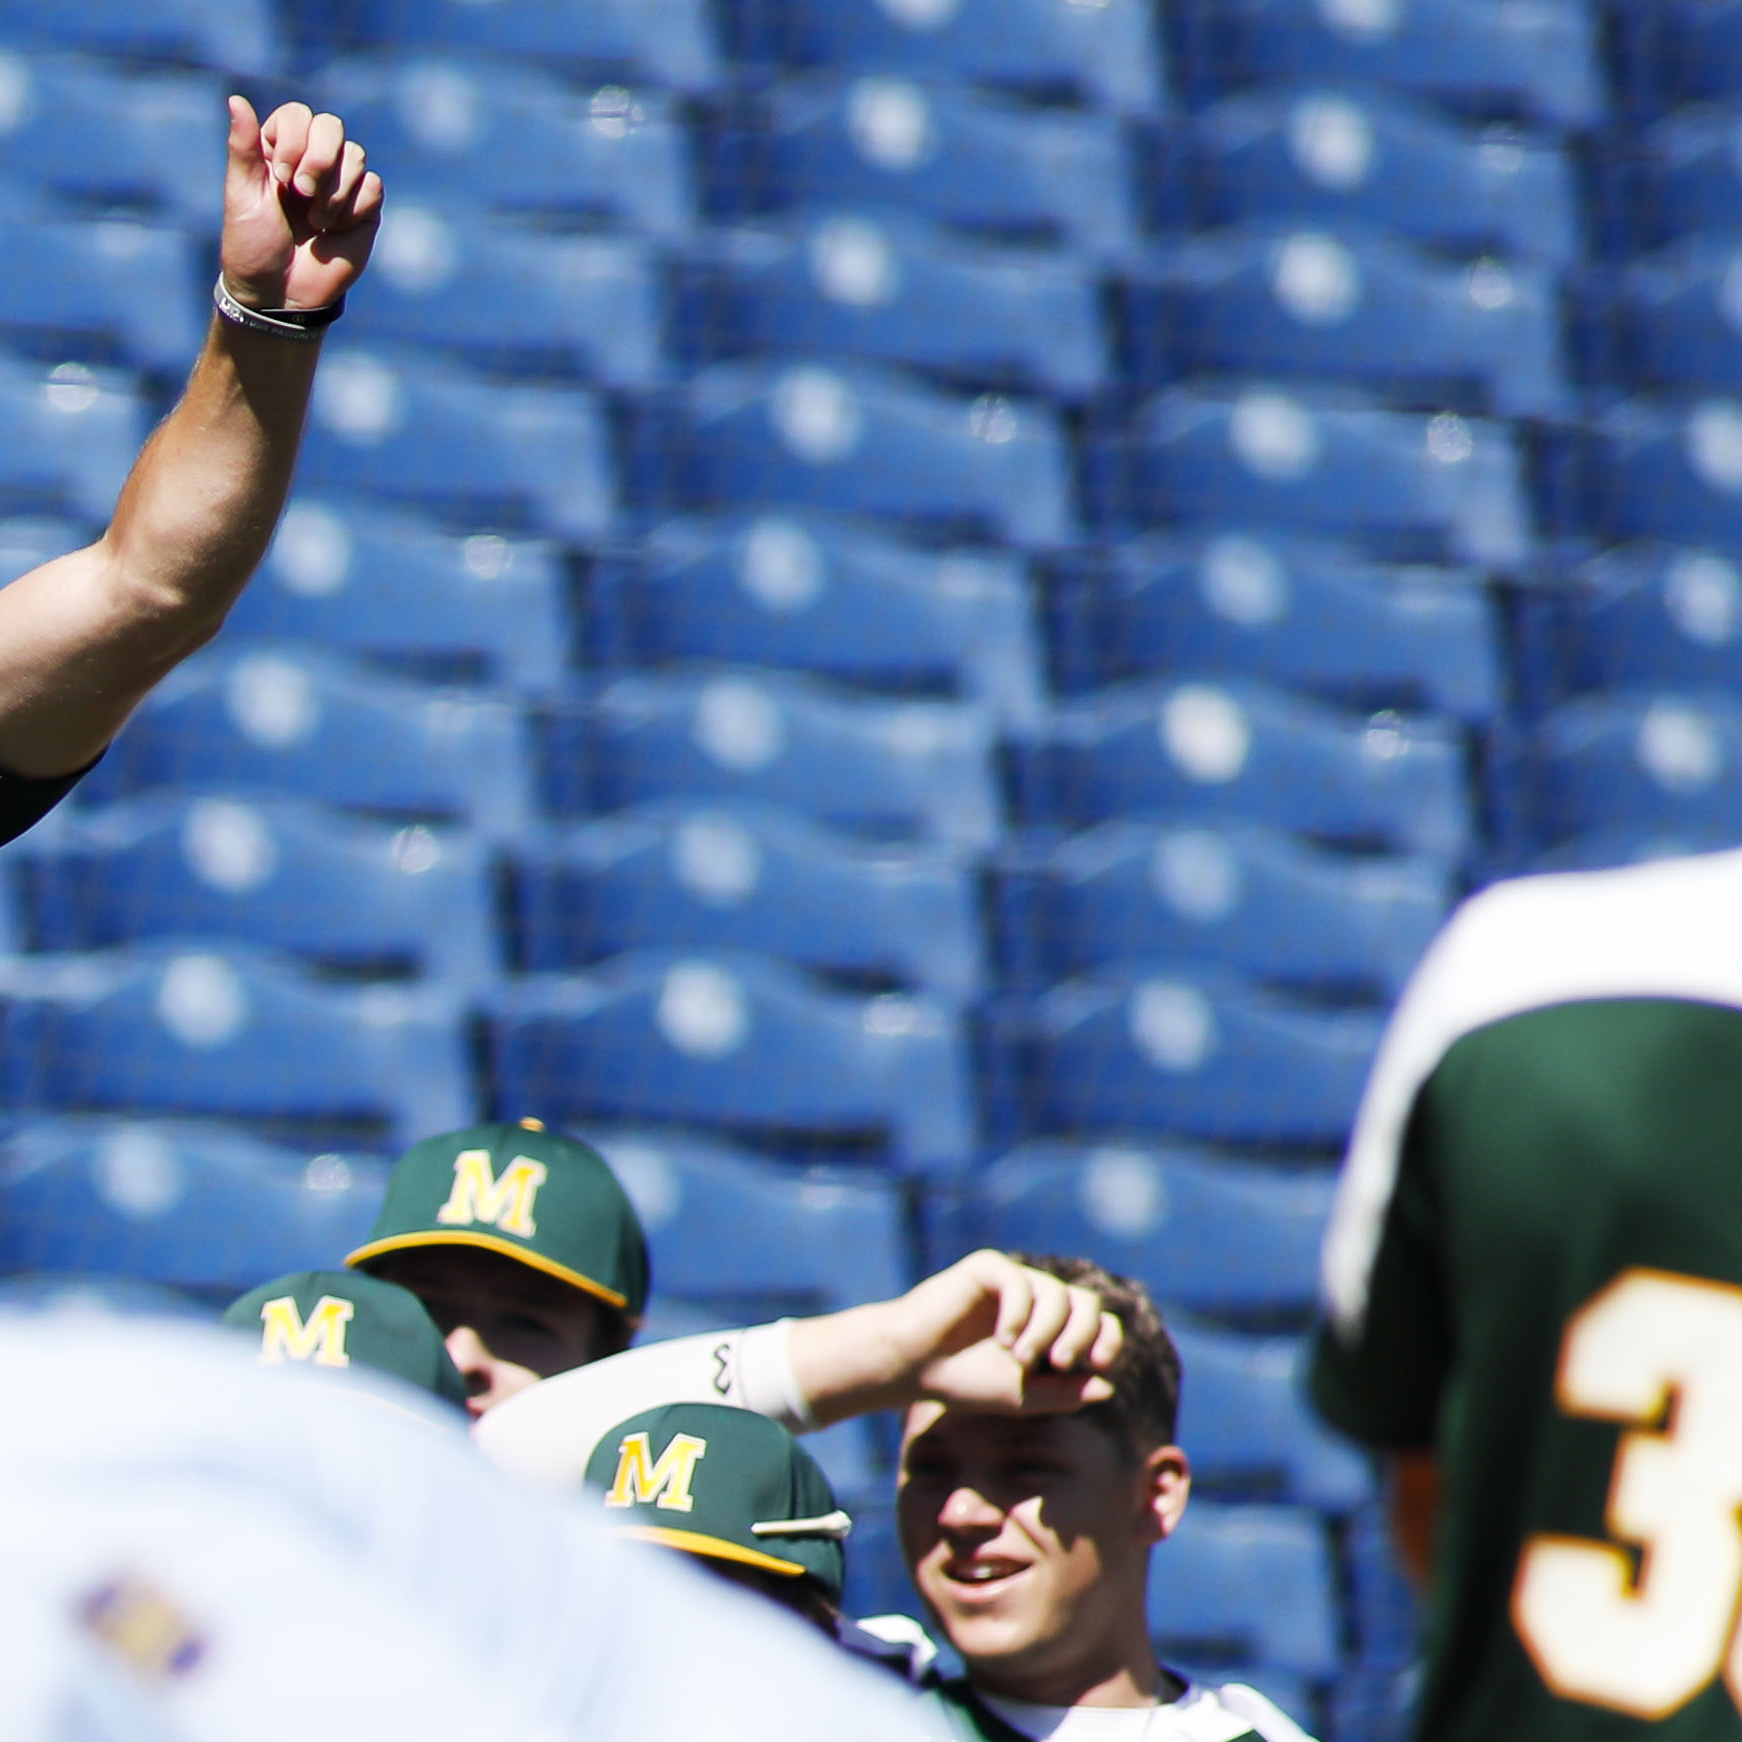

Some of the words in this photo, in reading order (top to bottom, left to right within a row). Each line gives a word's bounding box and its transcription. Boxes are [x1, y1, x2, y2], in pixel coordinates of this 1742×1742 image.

[436, 1149, 548, 1239] M
[259, 1294, 355, 1368] M
[604, 1430, 707, 1513] M
